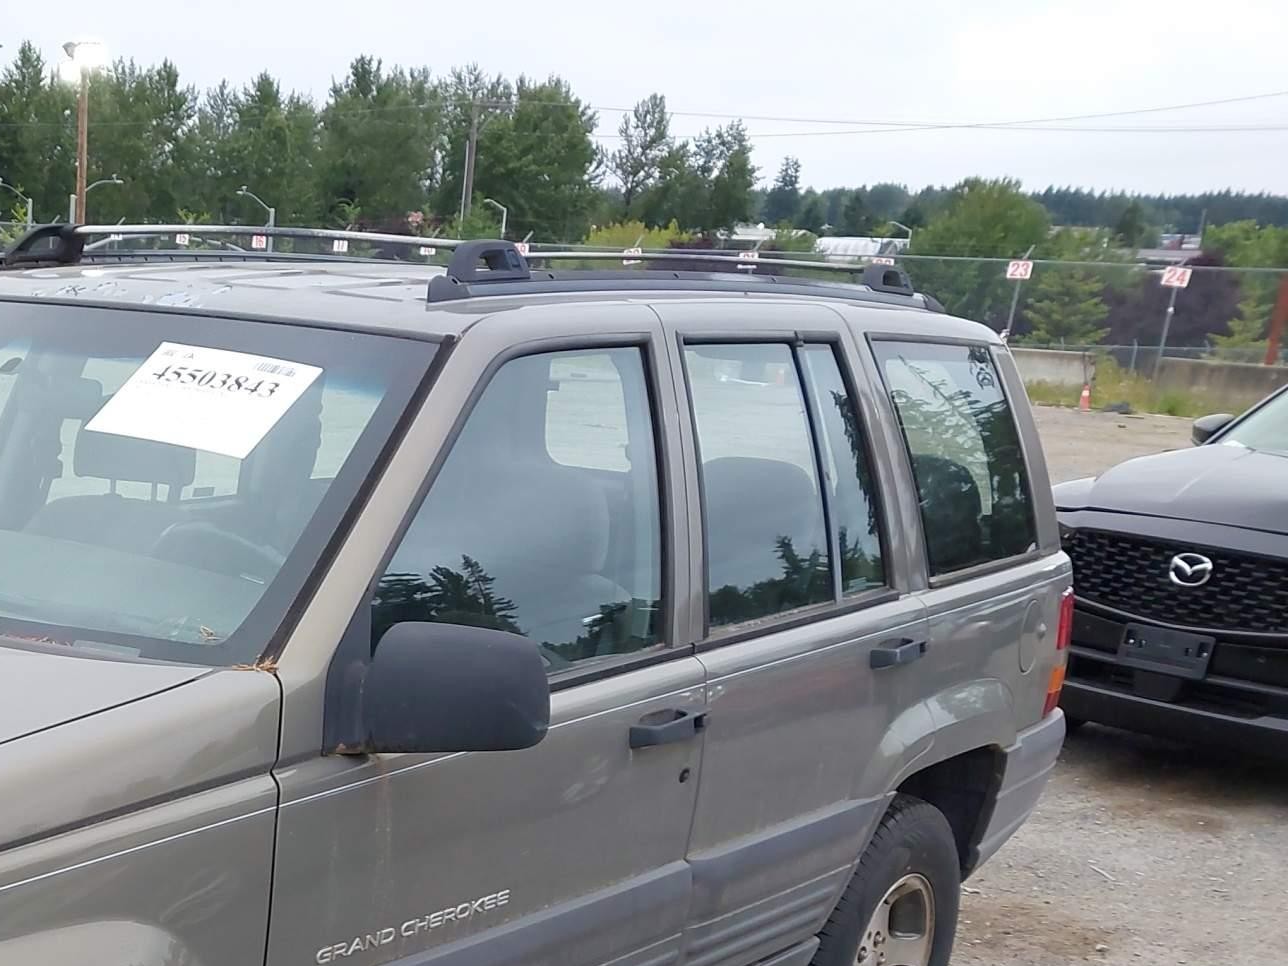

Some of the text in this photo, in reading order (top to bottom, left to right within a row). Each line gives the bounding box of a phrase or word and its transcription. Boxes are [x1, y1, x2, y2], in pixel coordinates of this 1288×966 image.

[1009, 262, 1030, 277] 23
[1164, 268, 1187, 285] 24
[152, 365, 280, 397] 45503843
[316, 889, 510, 964] GRAND CHEROKEE
